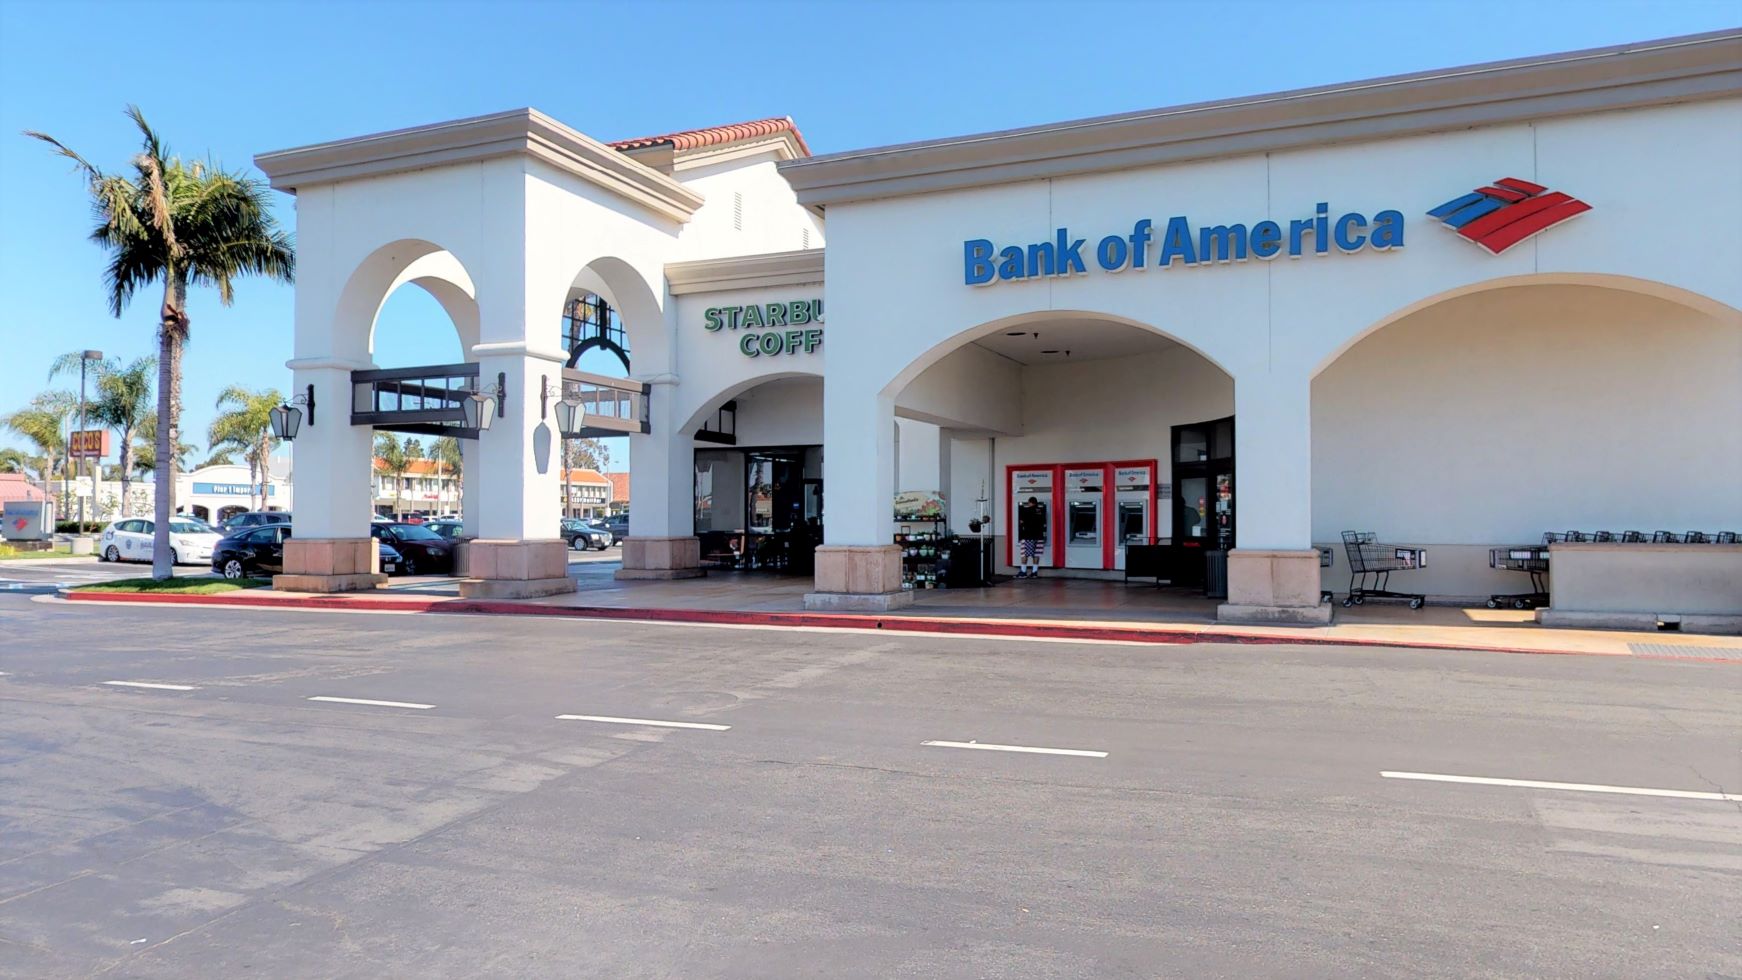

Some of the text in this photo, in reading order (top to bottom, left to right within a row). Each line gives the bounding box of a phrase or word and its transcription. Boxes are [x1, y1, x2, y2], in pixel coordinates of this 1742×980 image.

[964, 202, 1405, 286] Bank of America
